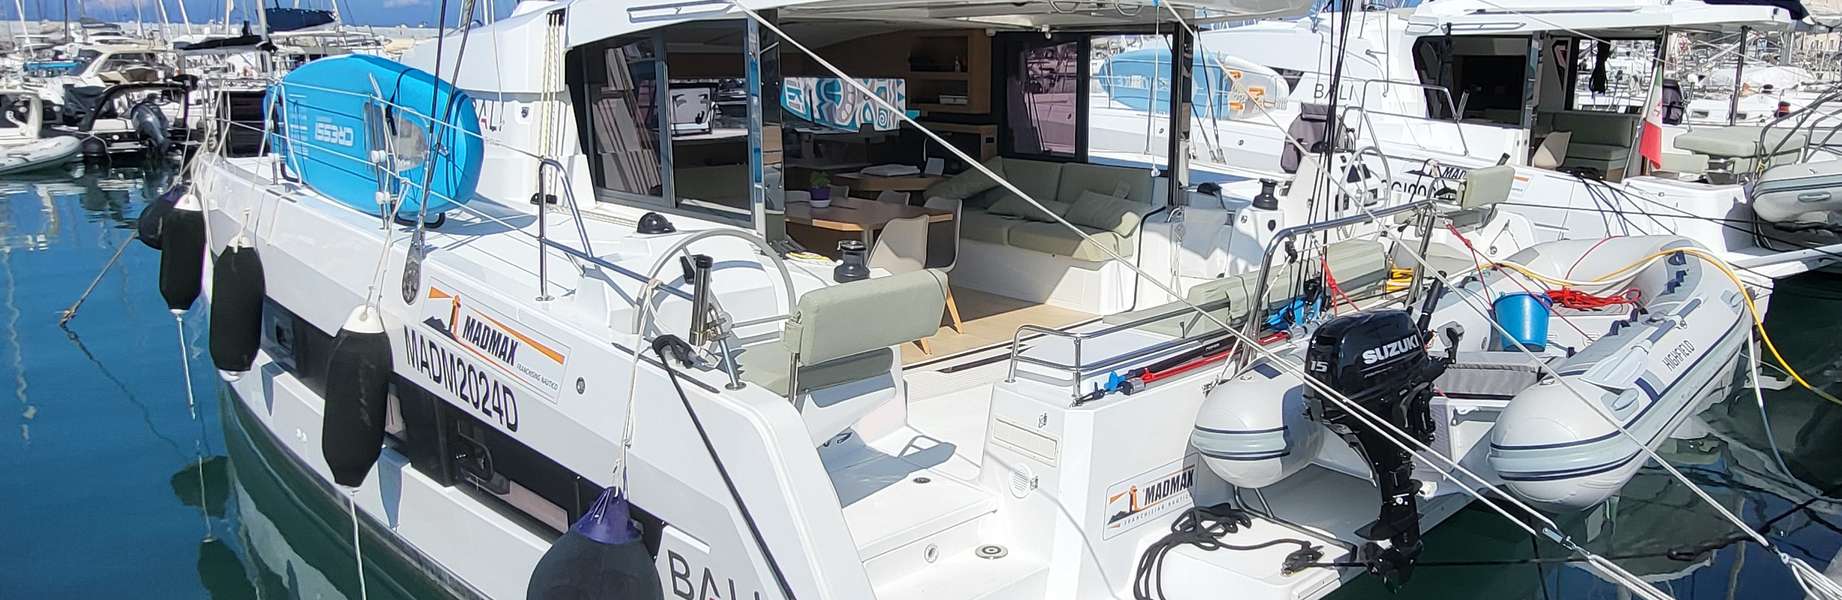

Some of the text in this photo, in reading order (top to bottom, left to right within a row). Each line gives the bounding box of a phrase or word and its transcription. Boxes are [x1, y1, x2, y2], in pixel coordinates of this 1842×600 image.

[474, 98, 505, 132] ALI
[463, 315, 519, 366] MADMAX
[1362, 335, 1420, 365] SUZUKI
[1662, 340, 1695, 371] HIGHFIELD
[404, 325, 519, 433] MADM2024D
[1310, 360, 1328, 373] 15
[1144, 468, 1195, 506] MADMAX
[668, 550, 762, 600] BA
